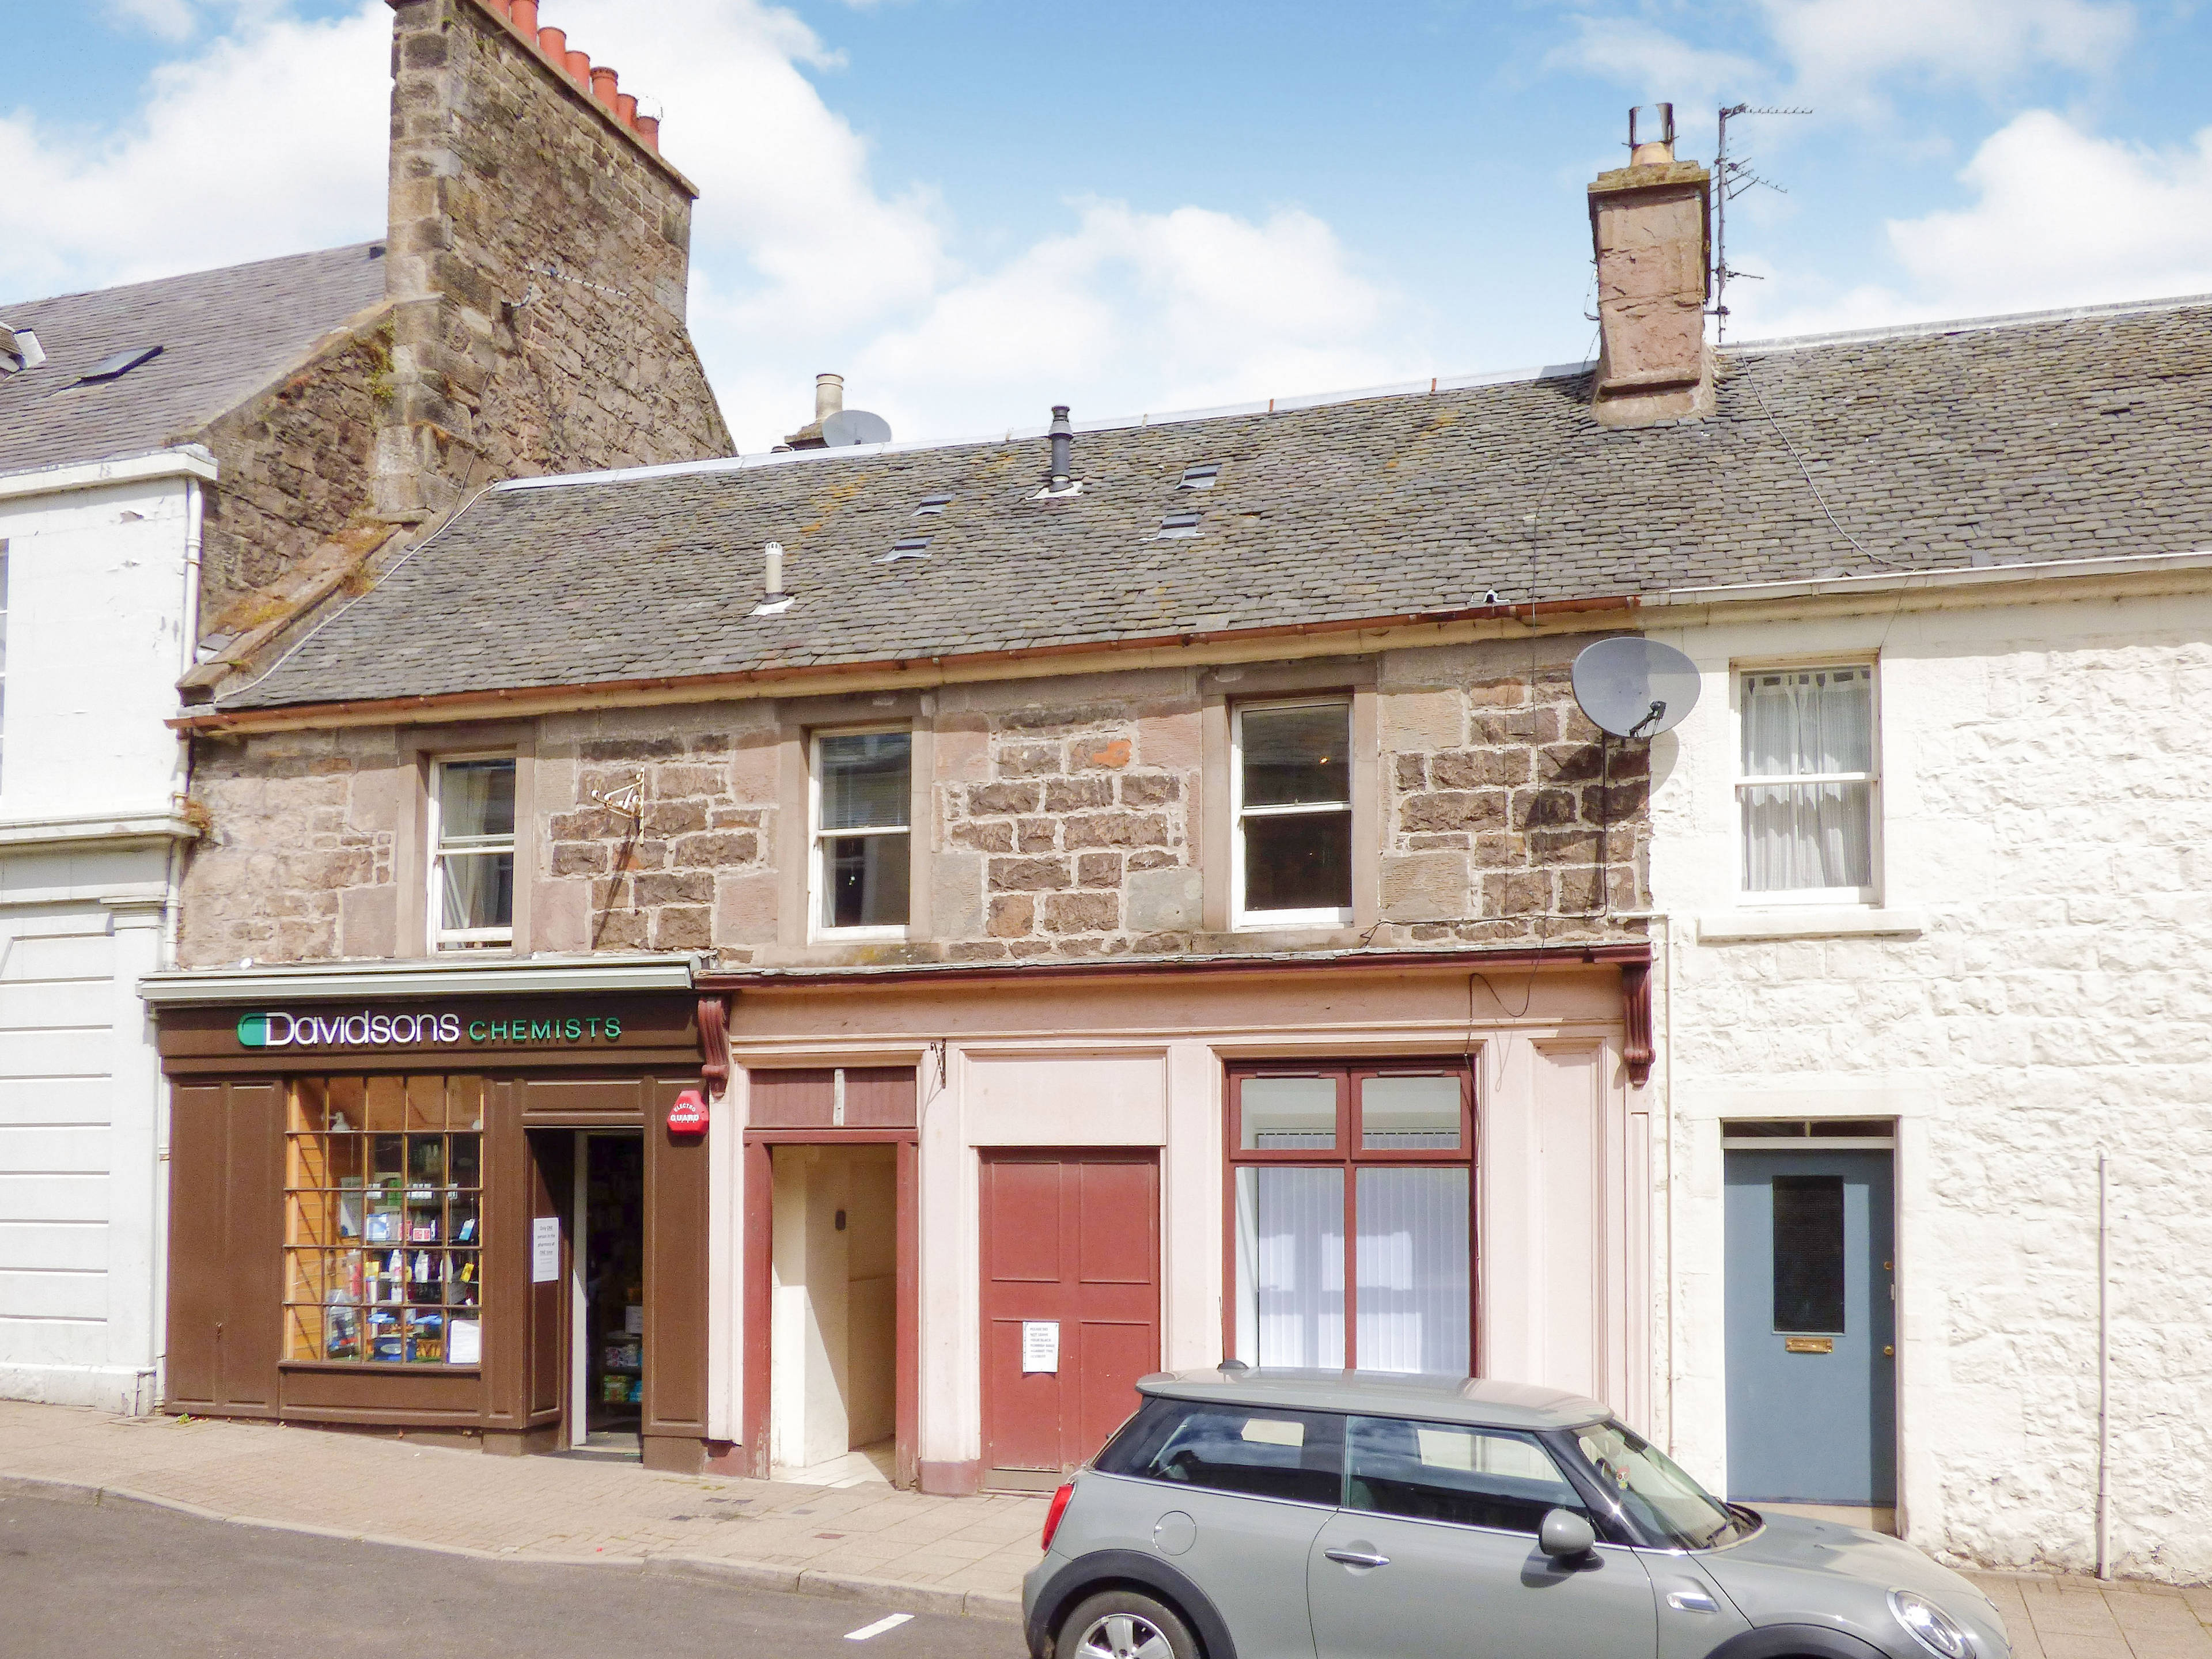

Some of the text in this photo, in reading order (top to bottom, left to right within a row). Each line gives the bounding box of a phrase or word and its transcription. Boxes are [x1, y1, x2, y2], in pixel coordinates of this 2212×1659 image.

[266, 1010, 622, 1046] Davidsons CHEMISTS
[673, 1103, 696, 1112] ELECTRO
[670, 1114, 699, 1122] GUARD
